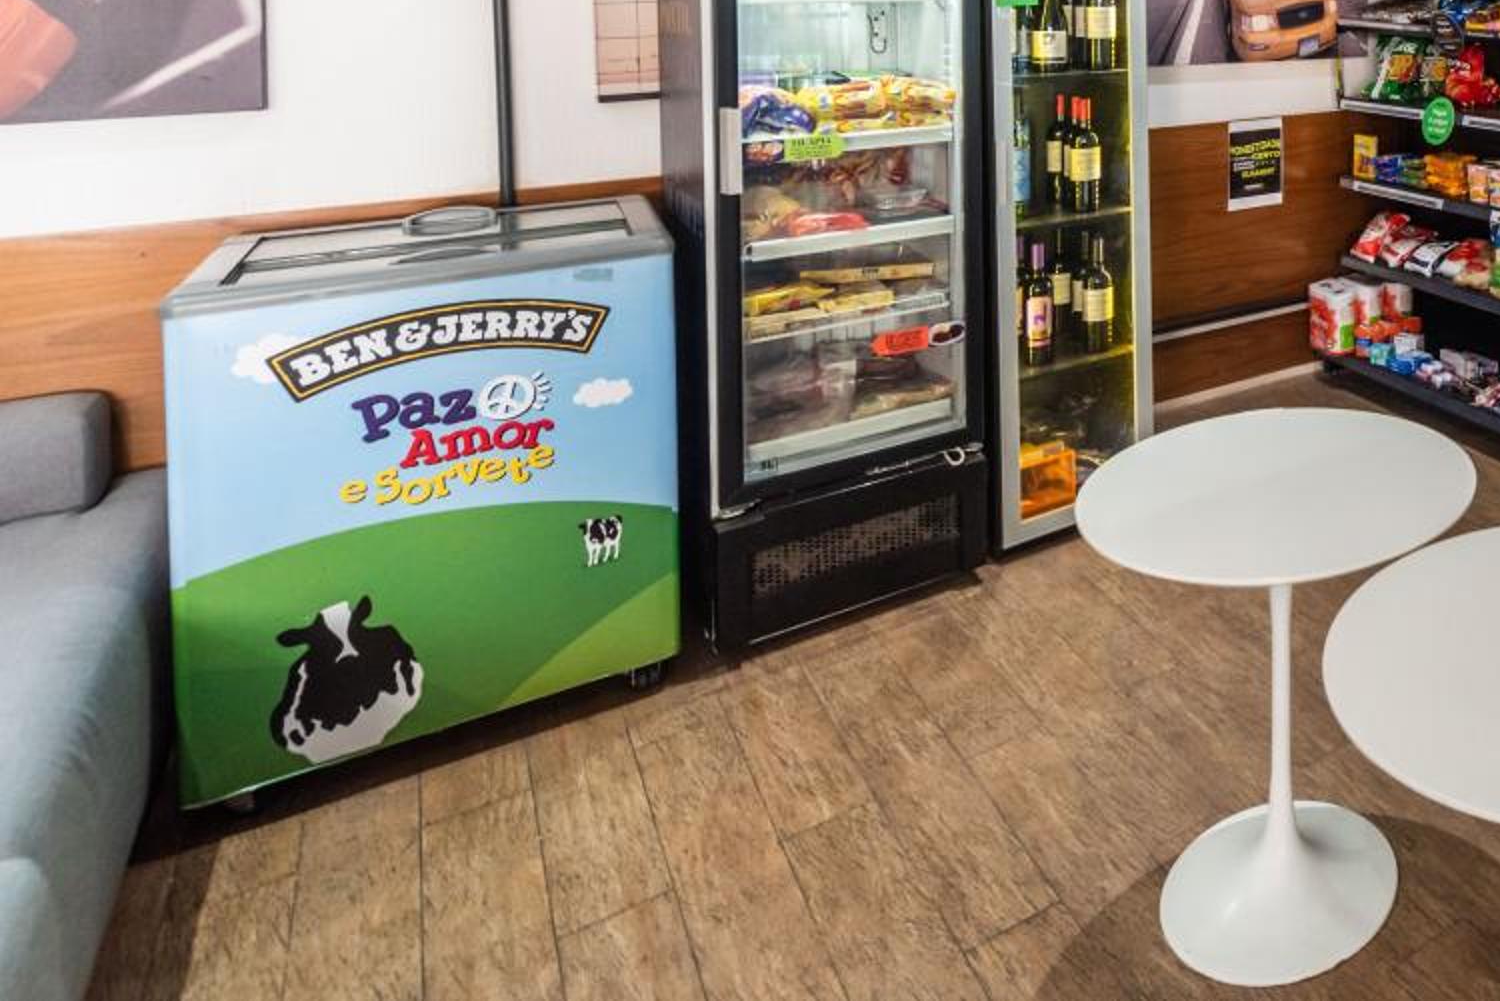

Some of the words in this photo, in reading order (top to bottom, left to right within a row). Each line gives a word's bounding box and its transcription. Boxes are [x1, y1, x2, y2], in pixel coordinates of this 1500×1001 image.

[290, 328, 393, 387] BEN
[394, 320, 432, 352] &
[431, 309, 594, 344] JERRY'S
[351, 389, 478, 444] Paz
[400, 417, 556, 469] Amor
[339, 479, 368, 504] e
[374, 446, 556, 506] Sorvete
